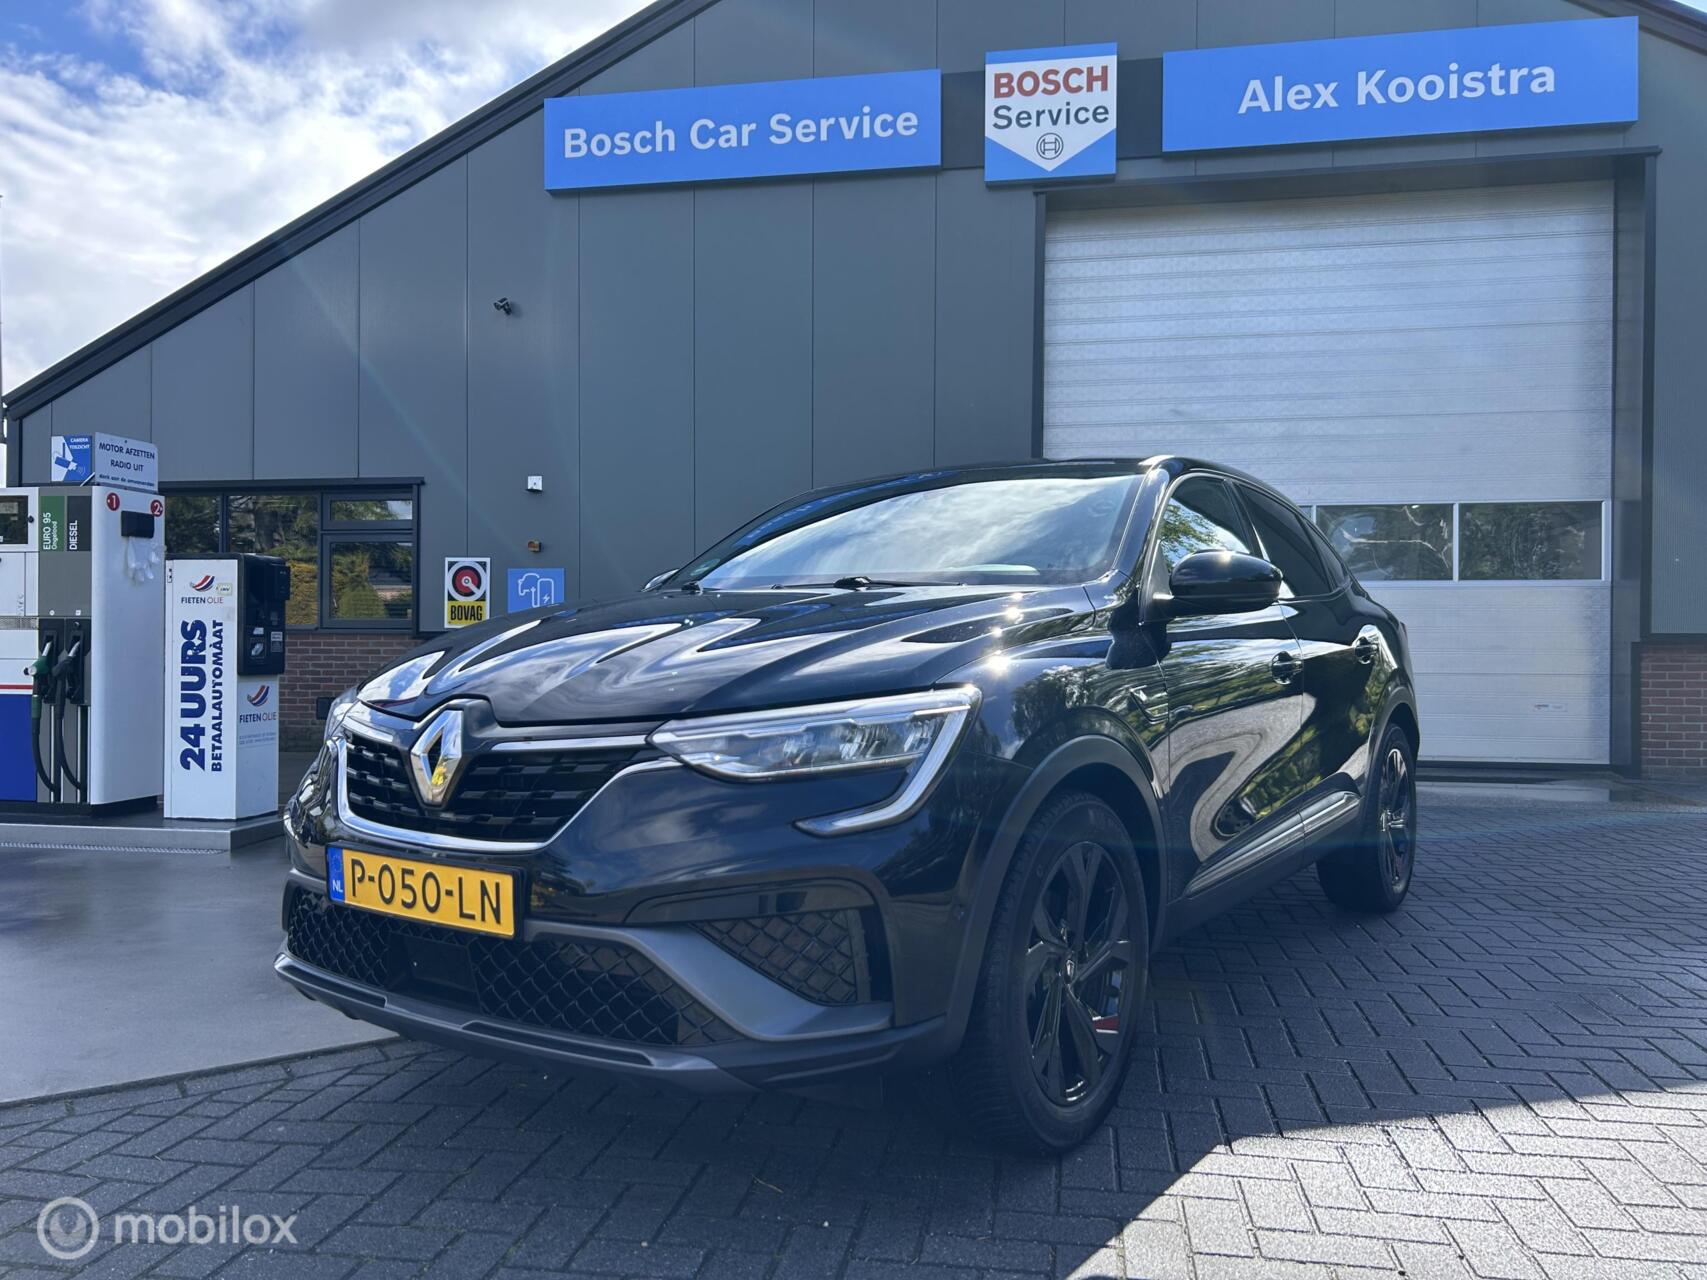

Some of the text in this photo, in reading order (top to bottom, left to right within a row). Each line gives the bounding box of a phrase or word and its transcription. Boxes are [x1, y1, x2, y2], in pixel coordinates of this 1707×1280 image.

[993, 65, 1110, 99] BOSCH
[1237, 62, 1555, 114] Alex Kooistra
[992, 100, 1110, 130] Service
[563, 105, 918, 159] Bosch Car Service
[99, 442, 155, 460] MOTOR AFZETTEN
[110, 459, 144, 472] RADIO UIT
[153, 502, 161, 515] 2
[43, 512, 51, 550] EURO 95
[69, 519, 78, 550] DIESEL
[450, 605, 483, 621] BOVAG
[180, 619, 207, 771] 24 UURS
[239, 713, 262, 723] FIETEN
[332, 880, 344, 894] NL
[350, 857, 502, 925] P-050-LN
